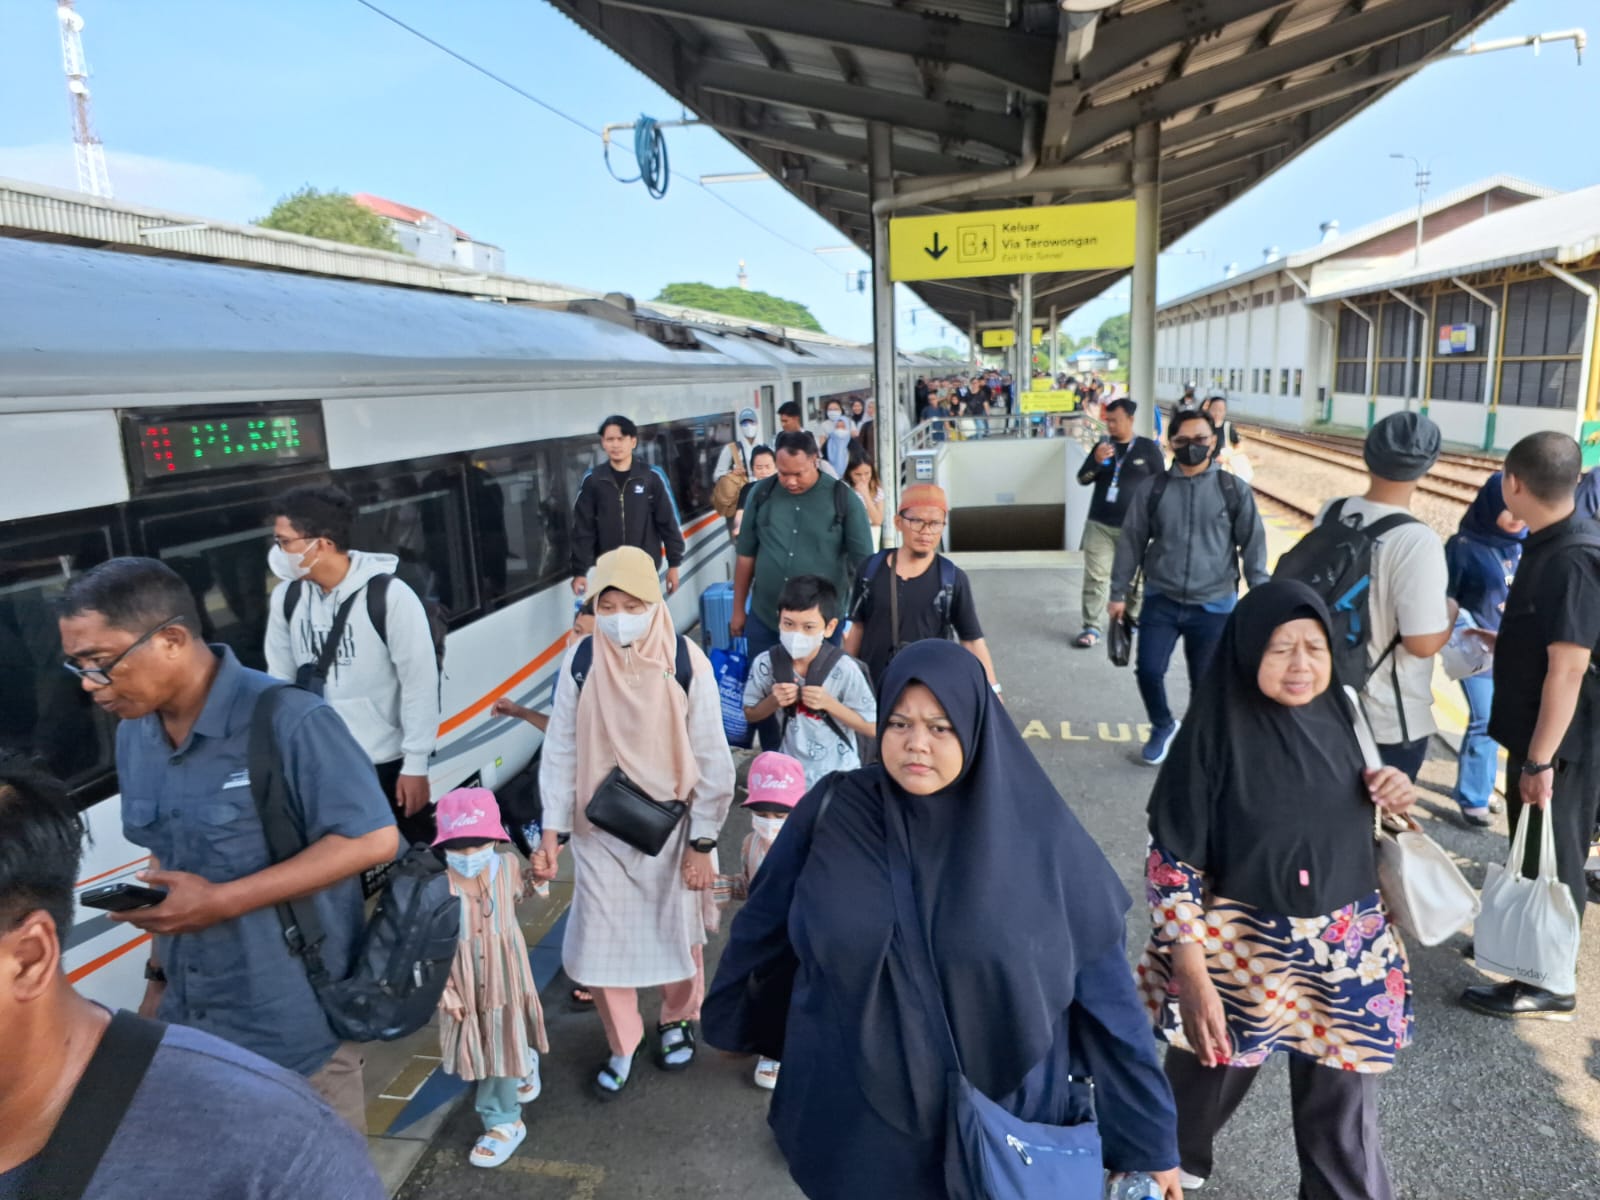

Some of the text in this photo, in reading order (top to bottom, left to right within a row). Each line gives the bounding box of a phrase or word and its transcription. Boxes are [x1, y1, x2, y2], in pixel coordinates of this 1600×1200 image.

[1002, 222, 1040, 233] Keluar
[1002, 237, 1097, 249] Via Terowongan
